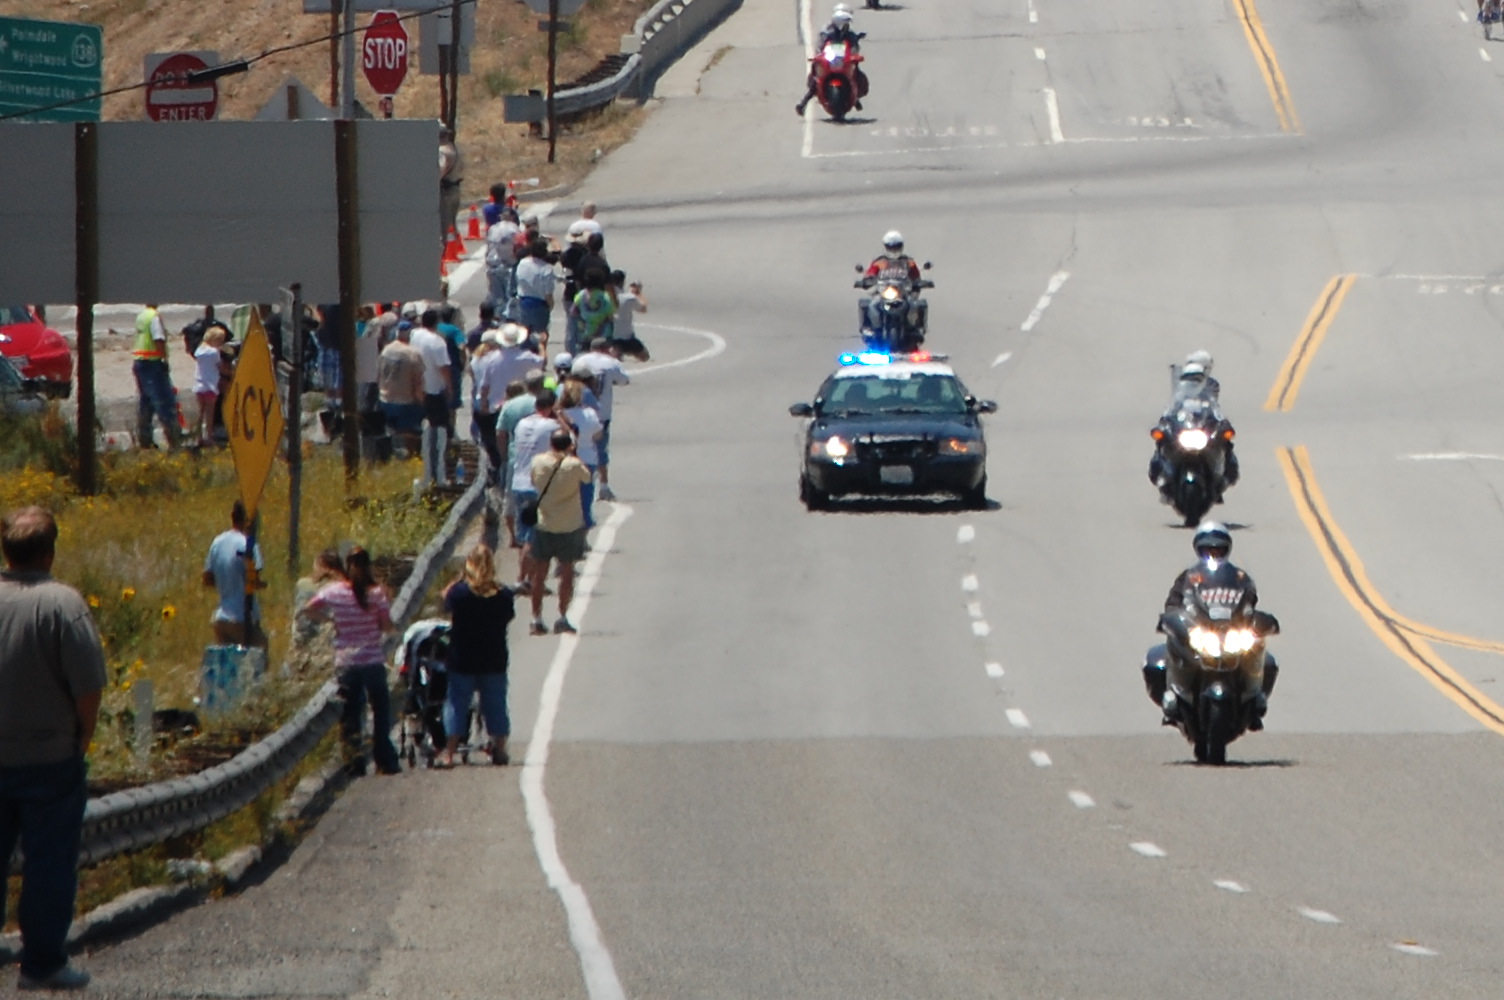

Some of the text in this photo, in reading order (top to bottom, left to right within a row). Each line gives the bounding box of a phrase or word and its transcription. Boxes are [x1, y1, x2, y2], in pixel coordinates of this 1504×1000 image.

[11, 28, 57, 43] Palmdale
[364, 37, 406, 69] STOP
[155, 72, 175, 87] DO
[158, 106, 206, 121] ENTER
[232, 382, 274, 445] ICY
